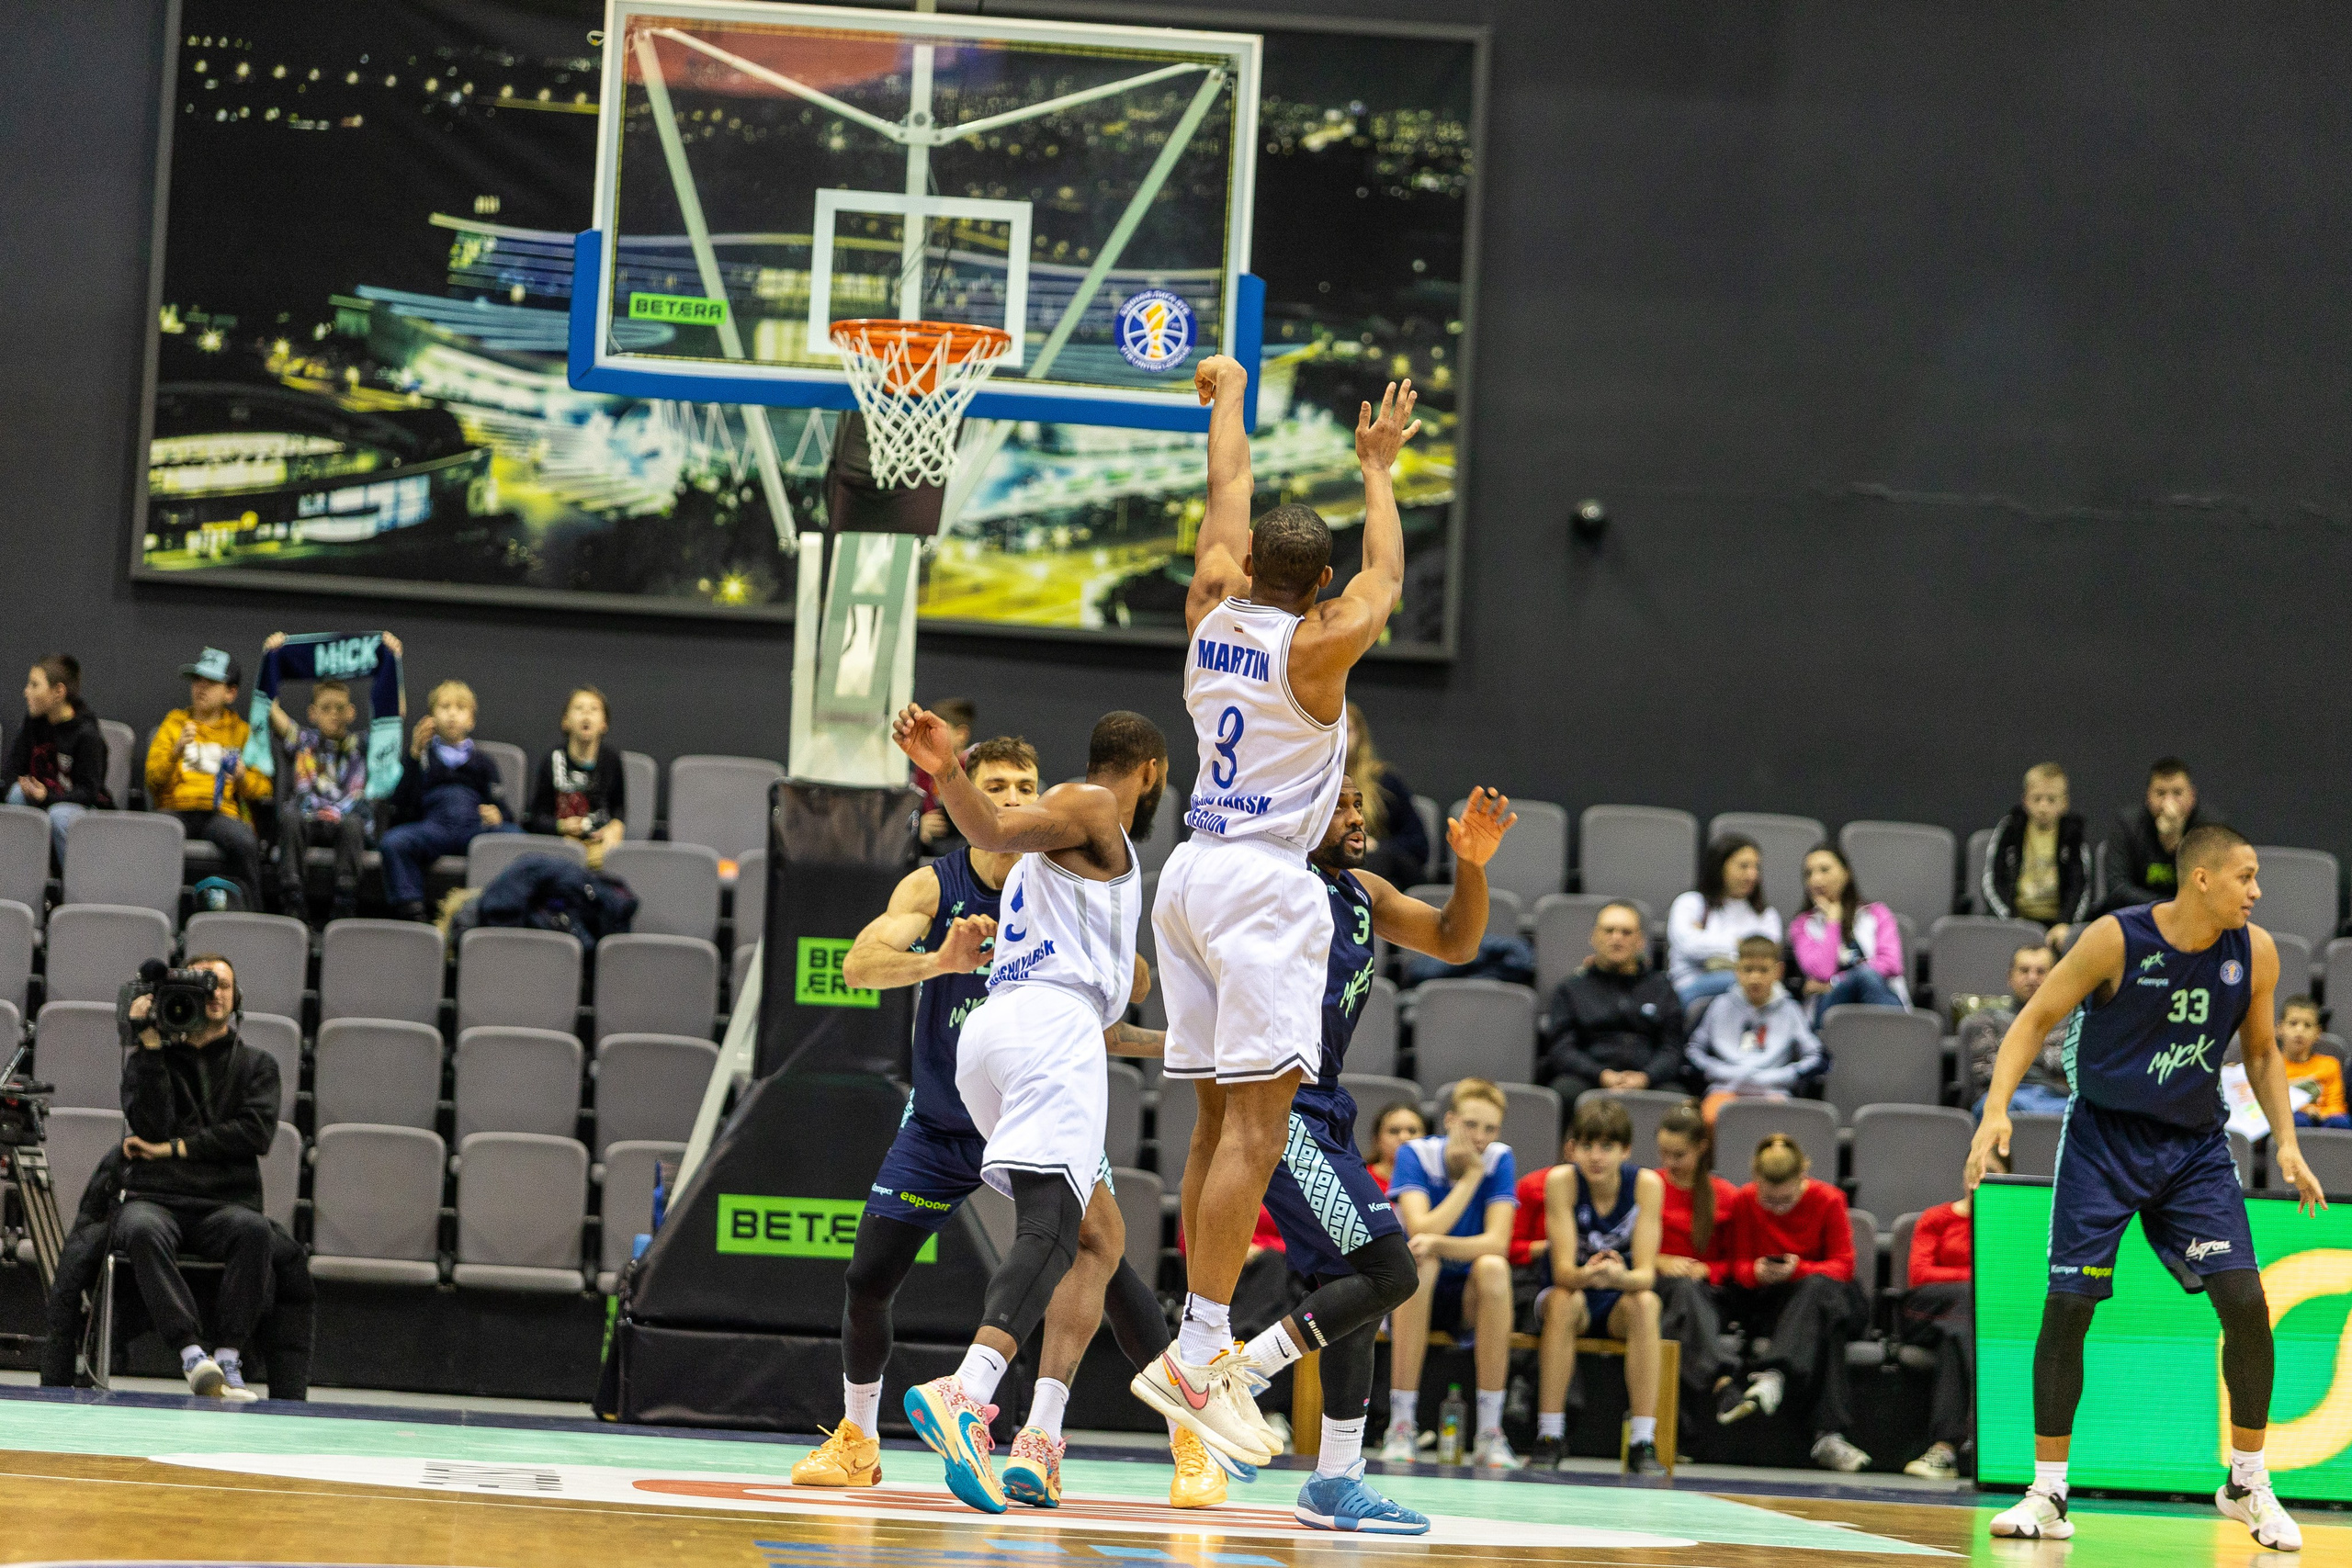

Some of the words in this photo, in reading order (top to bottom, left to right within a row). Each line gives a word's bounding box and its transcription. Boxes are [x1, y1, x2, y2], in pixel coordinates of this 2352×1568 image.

[1197, 639, 1270, 682] MARTIN
[1212, 705, 1245, 789] 3
[2166, 987, 2211, 1025] 33
